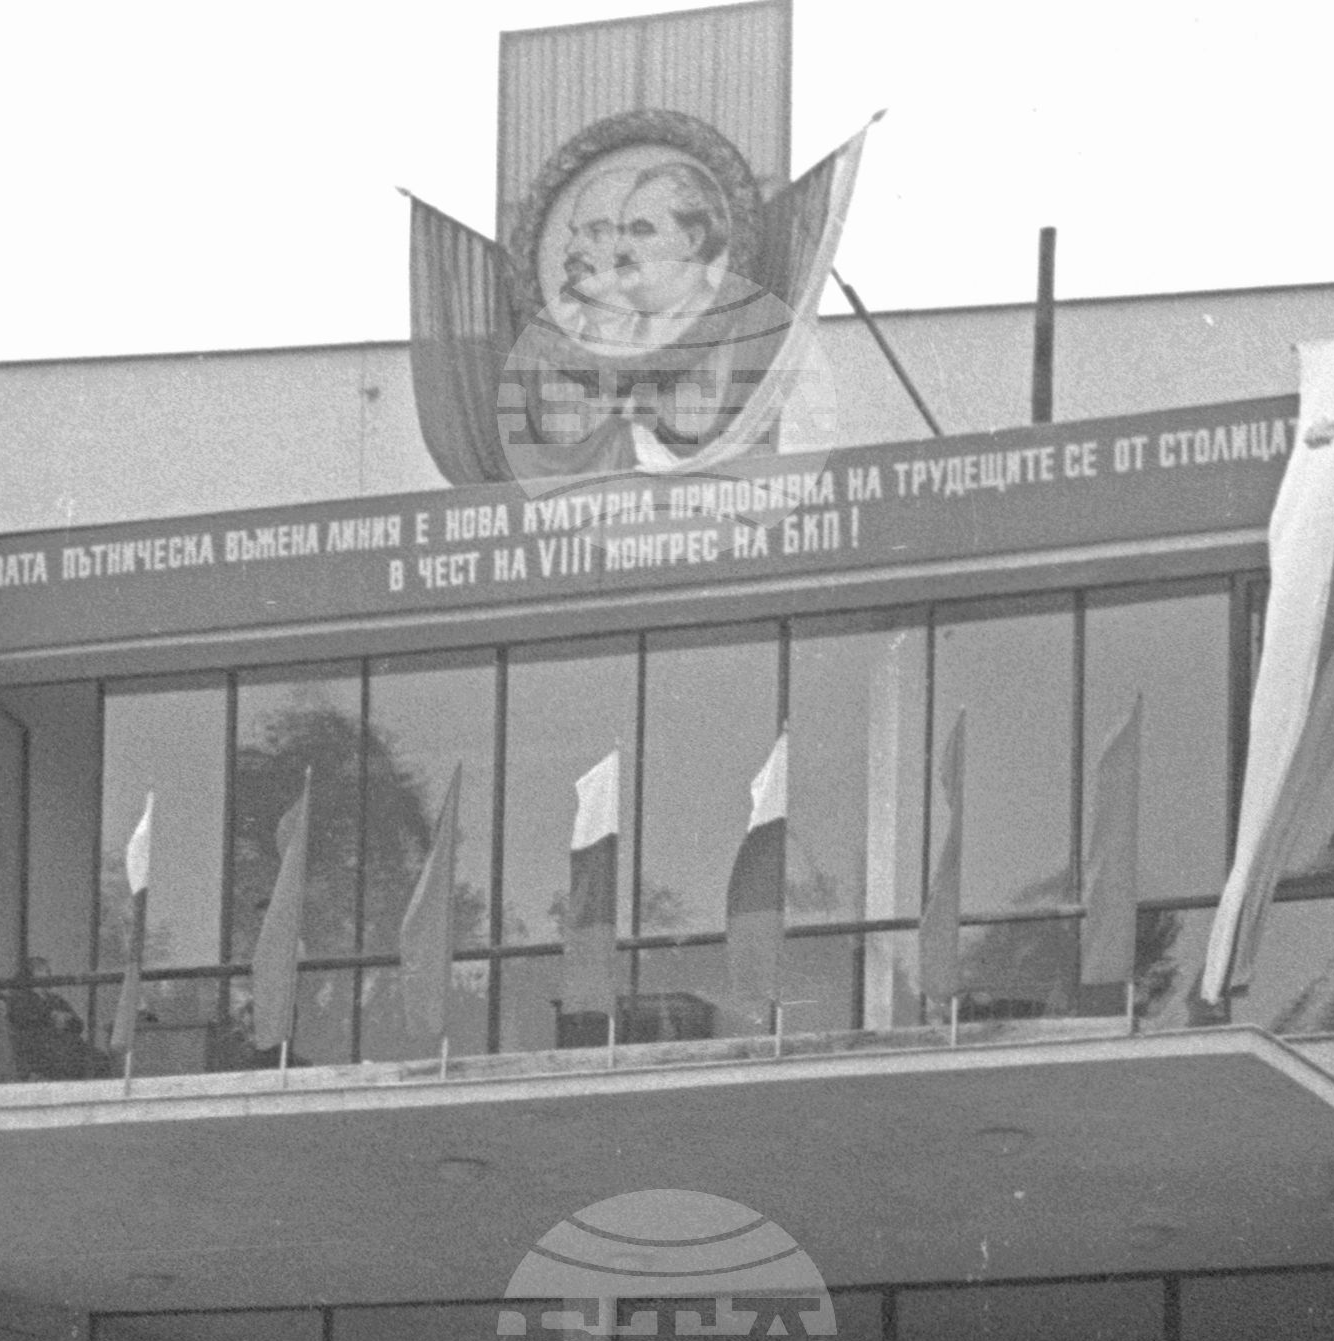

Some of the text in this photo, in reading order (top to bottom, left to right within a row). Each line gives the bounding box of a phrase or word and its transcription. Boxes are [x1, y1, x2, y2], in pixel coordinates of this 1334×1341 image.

[63, 534, 214, 580] ПЪТНИЧЕСКА
[225, 522, 319, 562] ВЪЖЕНА
[326, 515, 401, 551] ЛИНИЯ
[417, 512, 430, 544] Е
[445, 504, 509, 541] НОВА
[523, 489, 655, 533] КУЛТУРНА
[670, 471, 835, 522] ПРИДОБИВКА
[848, 466, 881, 501] НА
[893, 446, 1055, 497] ТРУДЕЩИТЕ
[1065, 441, 1097, 478] СЕ
[1113, 436, 1148, 472] ОТ
[388, 560, 404, 591] В
[418, 552, 480, 589] ЧЕСТ
[494, 548, 527, 581] НА
[538, 536, 591, 577] VIII
[605, 530, 718, 572] КОНГРЕС
[734, 526, 768, 559] НА
